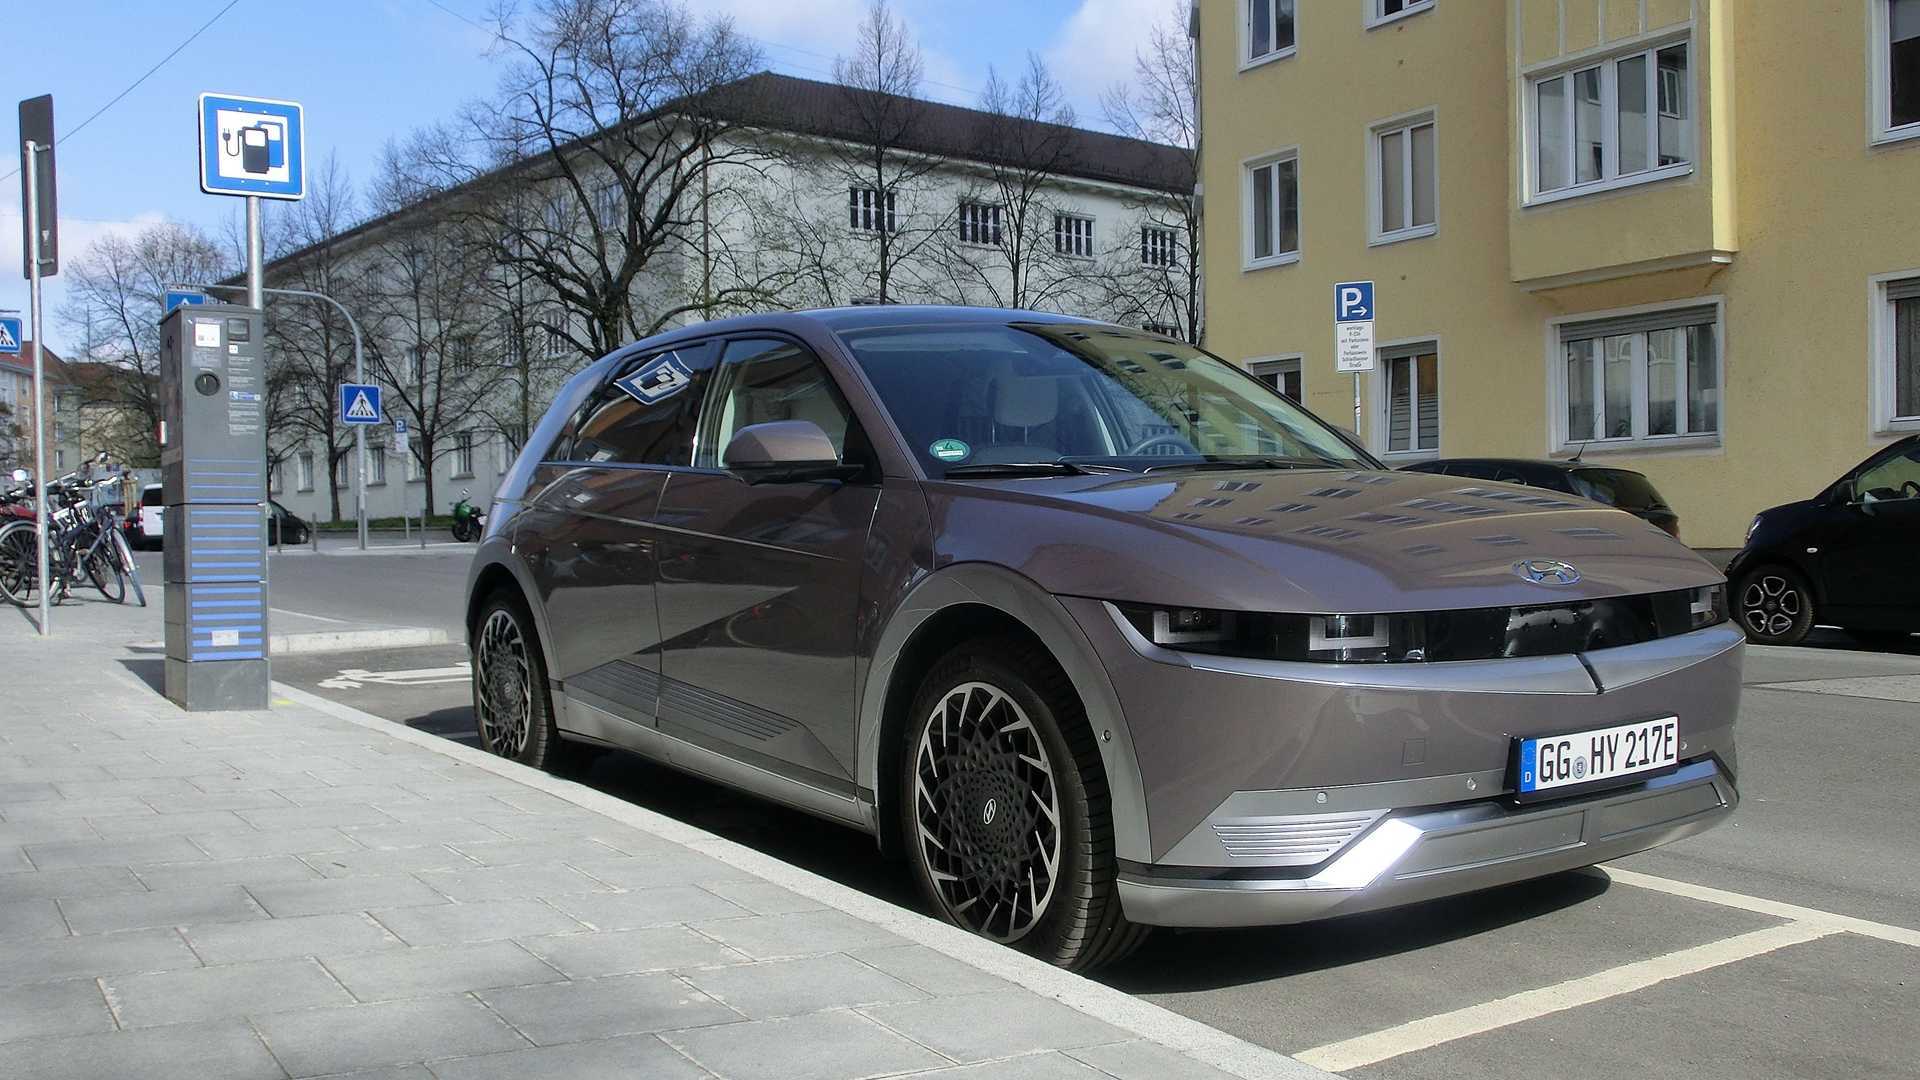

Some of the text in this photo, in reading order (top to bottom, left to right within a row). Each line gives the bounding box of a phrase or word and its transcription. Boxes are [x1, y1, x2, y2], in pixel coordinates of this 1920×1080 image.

[1341, 287, 1362, 318] P
[1539, 723, 1675, 783] GG HY 217E
[1524, 771, 1532, 783] D
